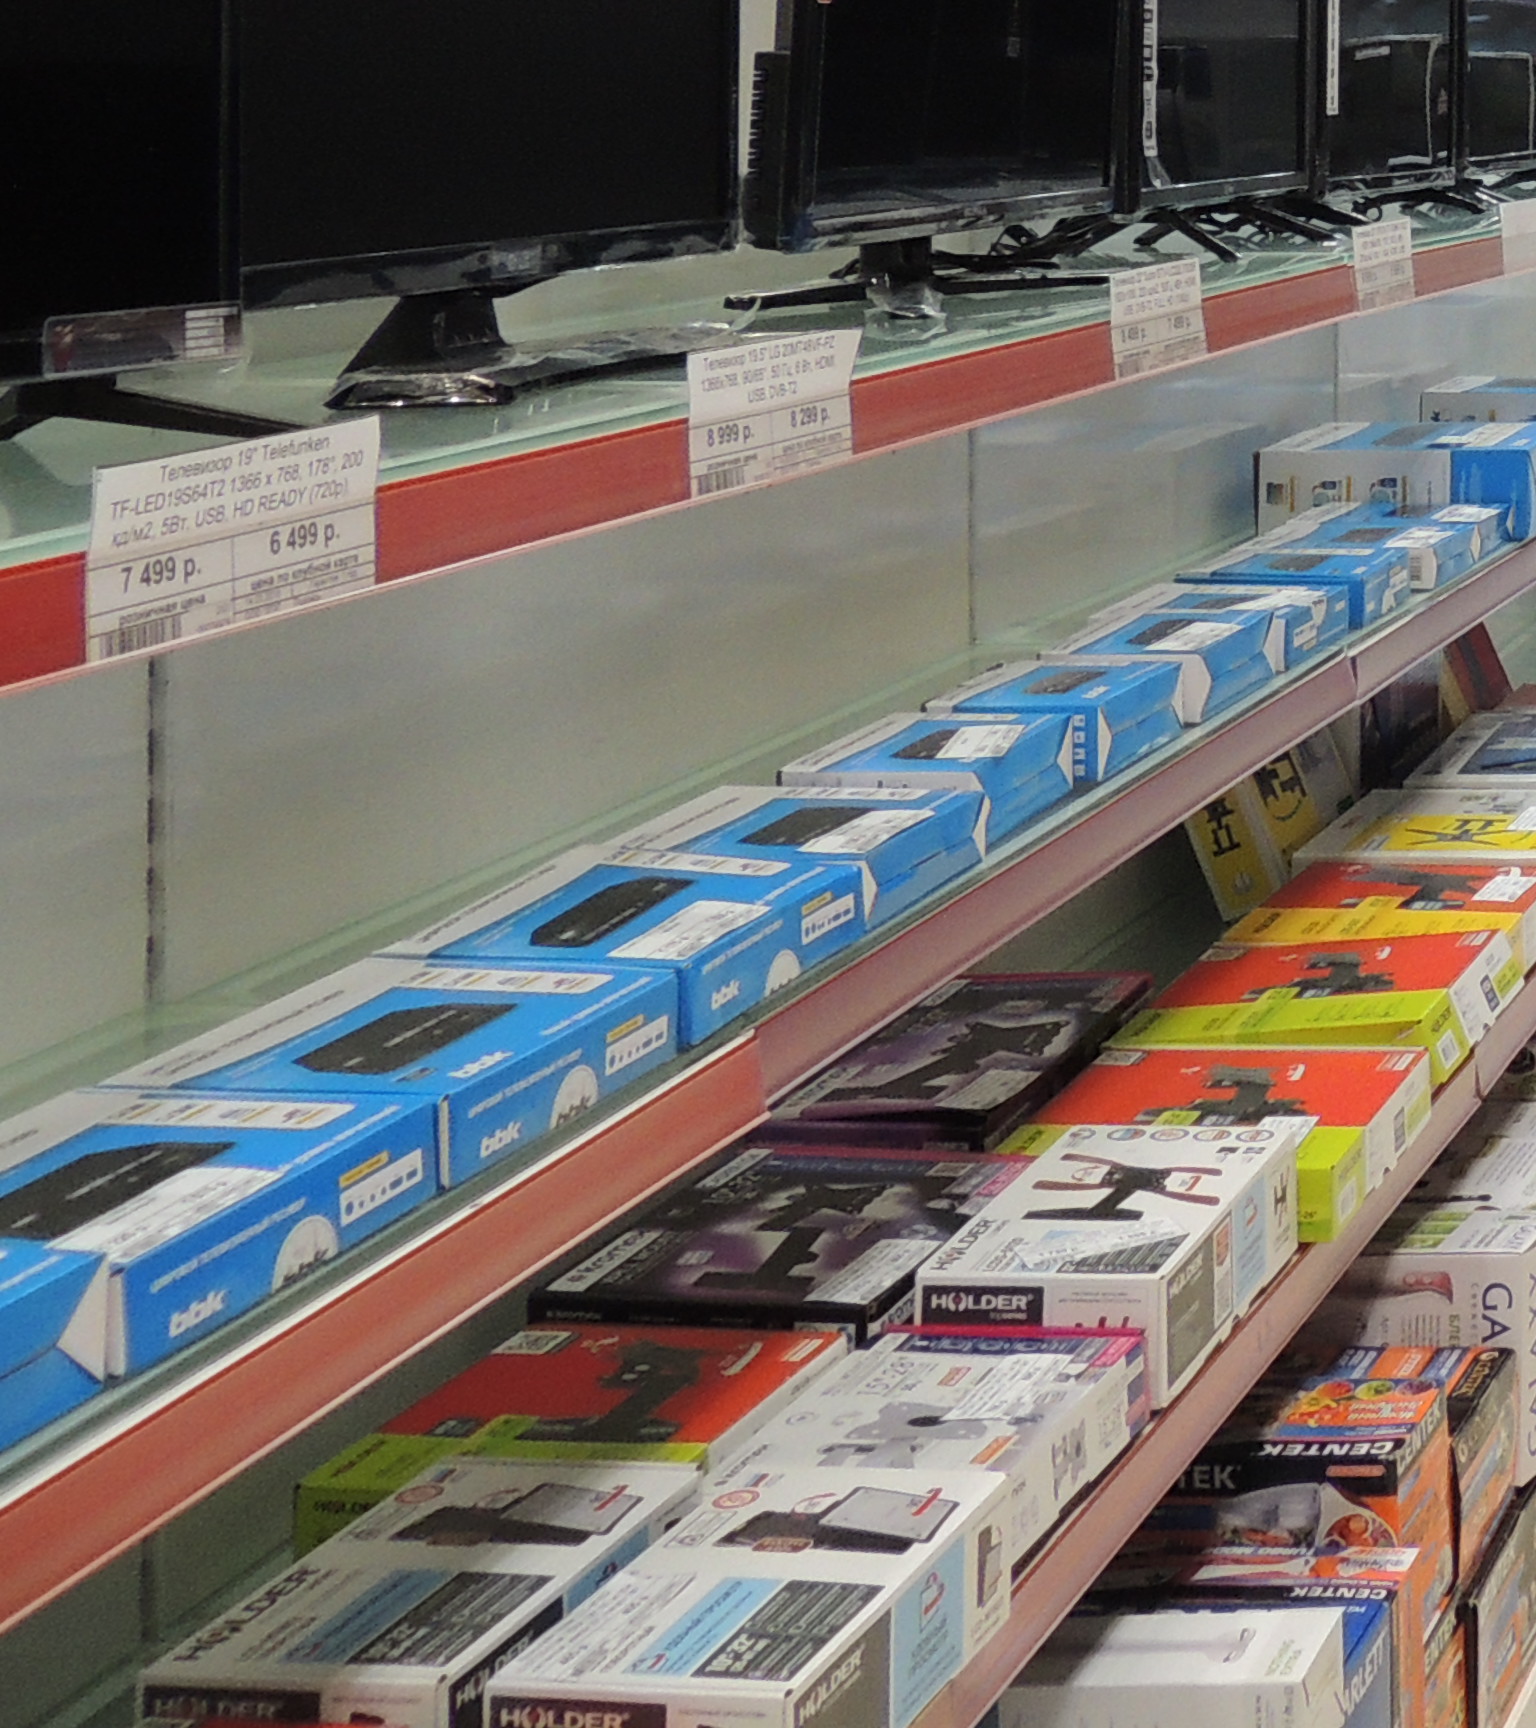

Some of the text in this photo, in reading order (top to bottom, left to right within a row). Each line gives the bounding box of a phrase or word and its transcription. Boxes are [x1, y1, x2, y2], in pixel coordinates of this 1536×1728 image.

[707, 428, 715, 447] 8
[717, 423, 739, 445] 999
[790, 409, 798, 428] 8
[160, 455, 233, 484] Телевизор
[262, 434, 331, 462] Telefunken
[341, 449, 364, 471] 200
[233, 499, 255, 521] HD
[258, 487, 306, 515] READY
[269, 530, 281, 555] 6
[286, 521, 318, 551] 499
[120, 567, 133, 594] 7
[139, 556, 177, 587] 499
[711, 978, 740, 1012] bbk
[480, 1120, 523, 1160] bbk
[930, 1217, 994, 1272] HOLDER
[168, 1288, 229, 1339] bbk
[930, 1293, 1034, 1313] HOLDER
[1258, 1441, 1401, 1457] CENTEK
[1178, 1465, 1242, 1490] TEK
[1288, 1585, 1389, 1600] CENTEK
[172, 1564, 322, 1663] HOLDER
[1424, 1610, 1457, 1675] ENTEK
[799, 1645, 864, 1724] HOLDER
[501, 1705, 632, 1728] HOLDER
